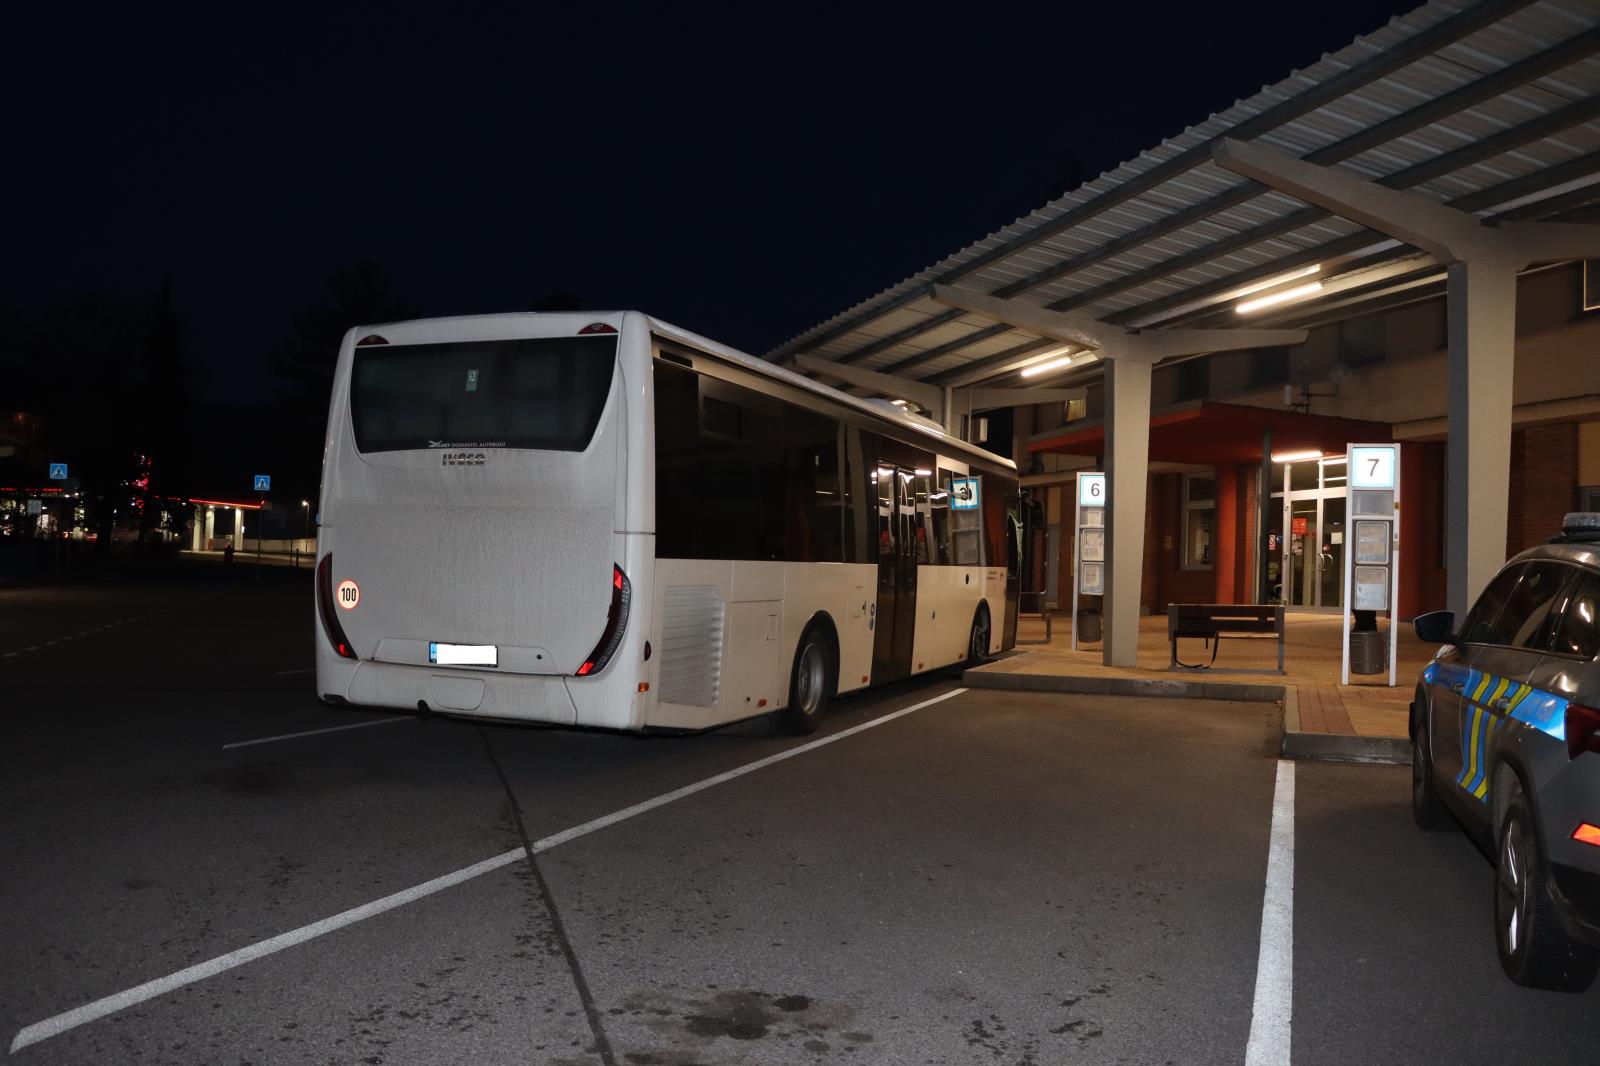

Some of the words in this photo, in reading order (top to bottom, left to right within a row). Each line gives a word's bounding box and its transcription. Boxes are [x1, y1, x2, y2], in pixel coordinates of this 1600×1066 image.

[442, 453, 485, 466] IVECO
[1367, 458, 1380, 477] 7
[1090, 482, 1100, 497] 6
[341, 587, 357, 602] 100
